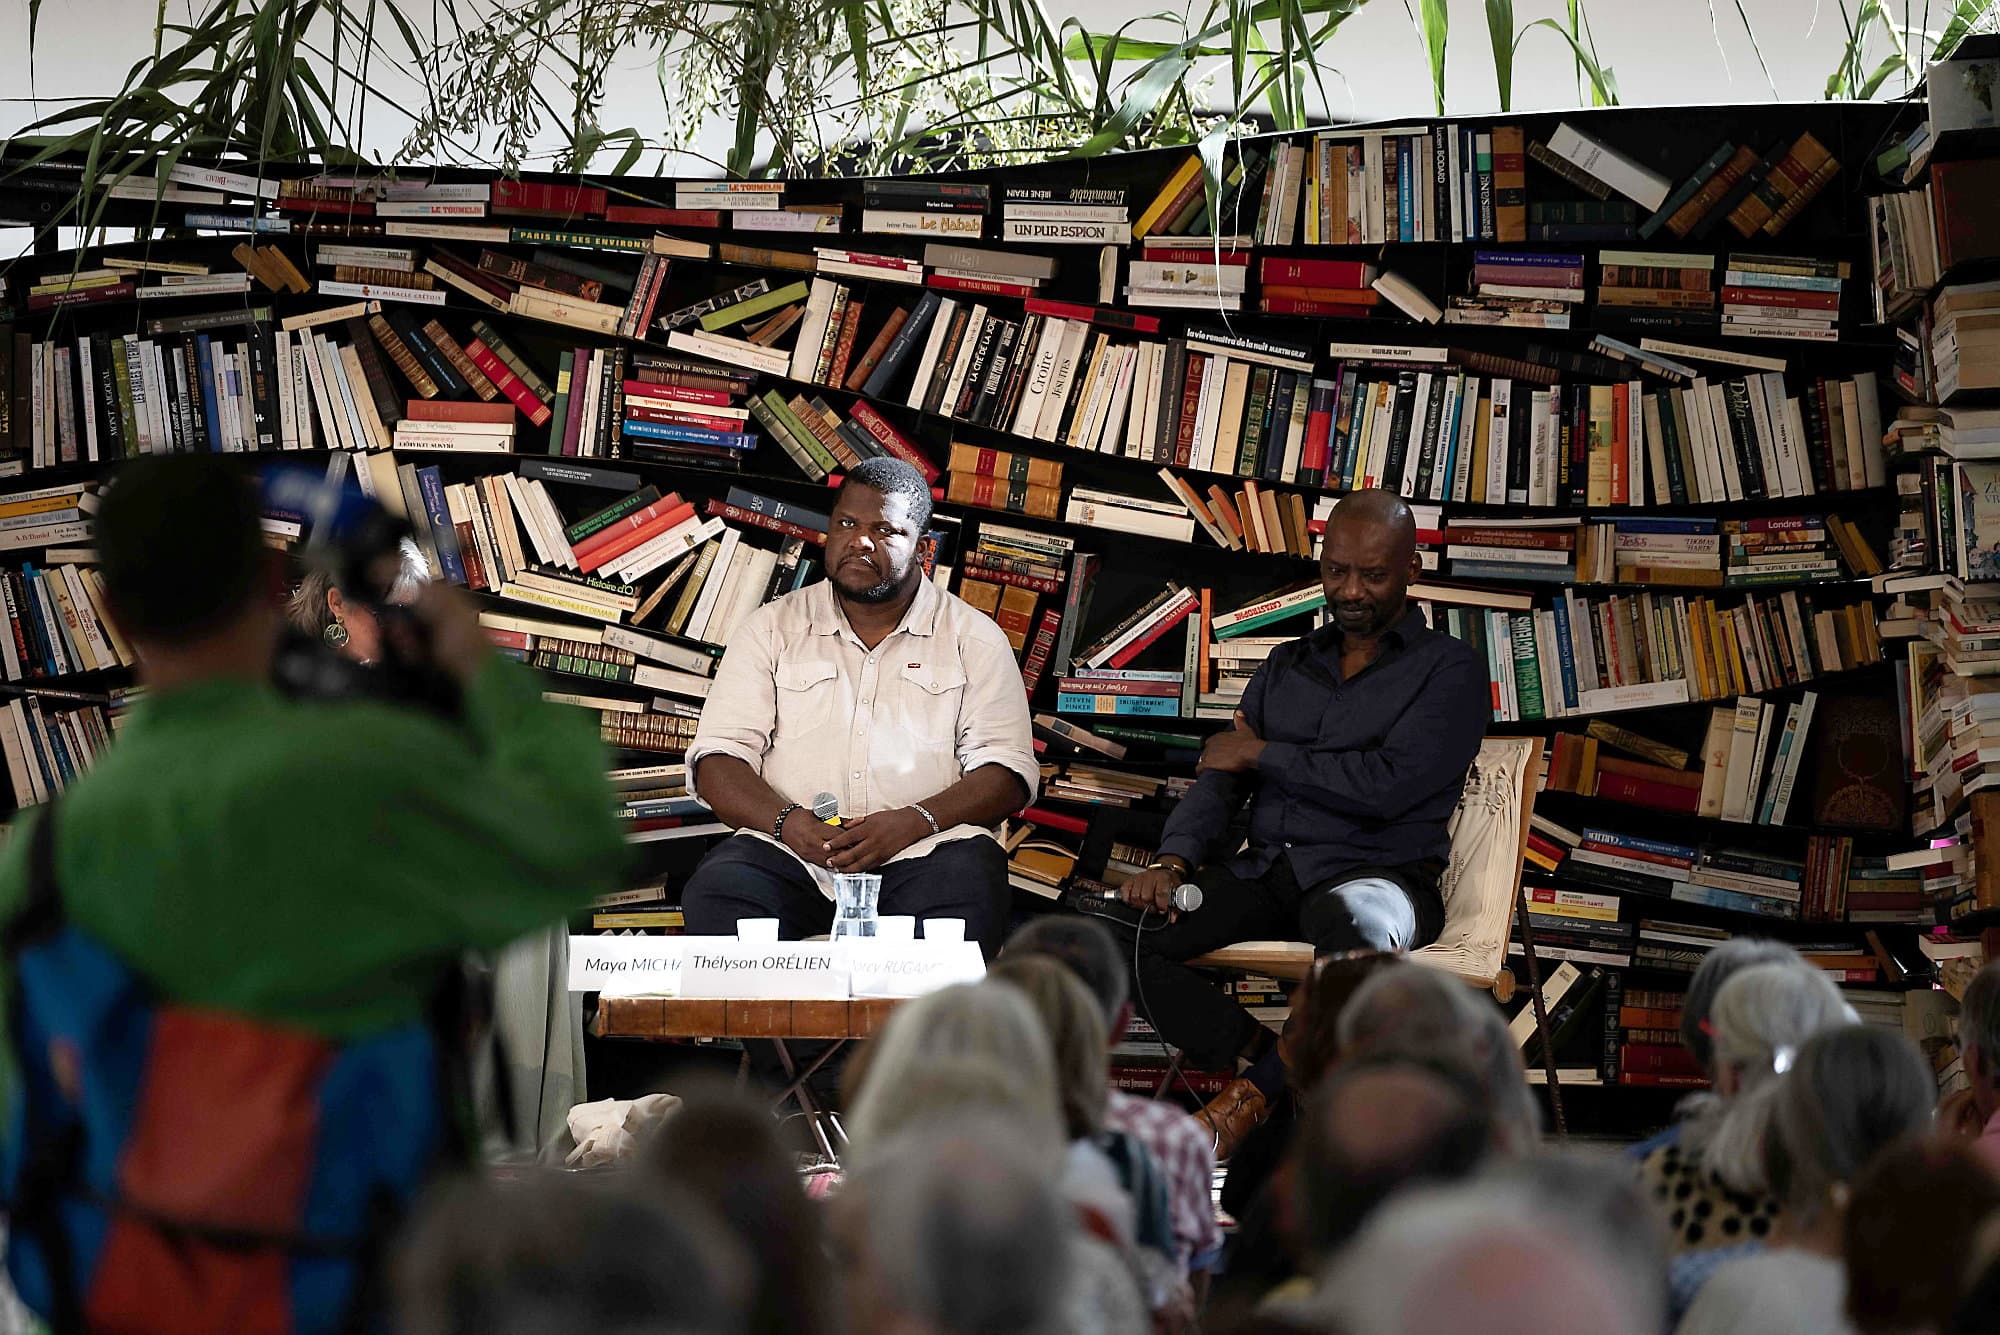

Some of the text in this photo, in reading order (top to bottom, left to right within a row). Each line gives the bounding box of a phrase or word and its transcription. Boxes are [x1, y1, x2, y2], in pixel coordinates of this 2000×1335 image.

[1435, 127, 1444, 183] Lucien BODARD
[728, 183, 781, 192] LE TOUMELIN
[1006, 189, 1051, 198] IRÈNE FRAIN
[1013, 207, 1023, 215] Les
[920, 216, 936, 233] Le
[1014, 224, 1105, 238] UN PUR ESPION
[520, 230, 550, 240] PARIS
[571, 235, 589, 244] SES
[966, 281, 979, 289] TAXI
[984, 317, 997, 334] JOIE
[980, 333, 992, 345] LA
[1237, 338, 1246, 347] de
[1246, 340, 1255, 349] la
[976, 344, 988, 356] DE
[123, 339, 146, 404] LES SABLES DU TEMPS
[967, 371, 978, 382] LA
[1029, 350, 1054, 395] Croire
[296, 377, 303, 385] LA
[100, 368, 118, 435] MONT AIGOUAL
[1728, 378, 1751, 418] Delia
[1561, 426, 1569, 443] CLARK
[430, 441, 453, 449] FRANCIS
[1768, 519, 1801, 528] Londres
[1047, 537, 1068, 548] DELLY
[1618, 535, 1647, 547] Tess
[586, 575, 634, 597] Histoire d'O
[1233, 599, 1281, 621] CATASTROPHE
[1512, 615, 1542, 715] ERICH SEGAL DOCTEURS
[585, 957, 628, 973] Maya
[693, 953, 831, 972] Thélyson ORÉLIEN
